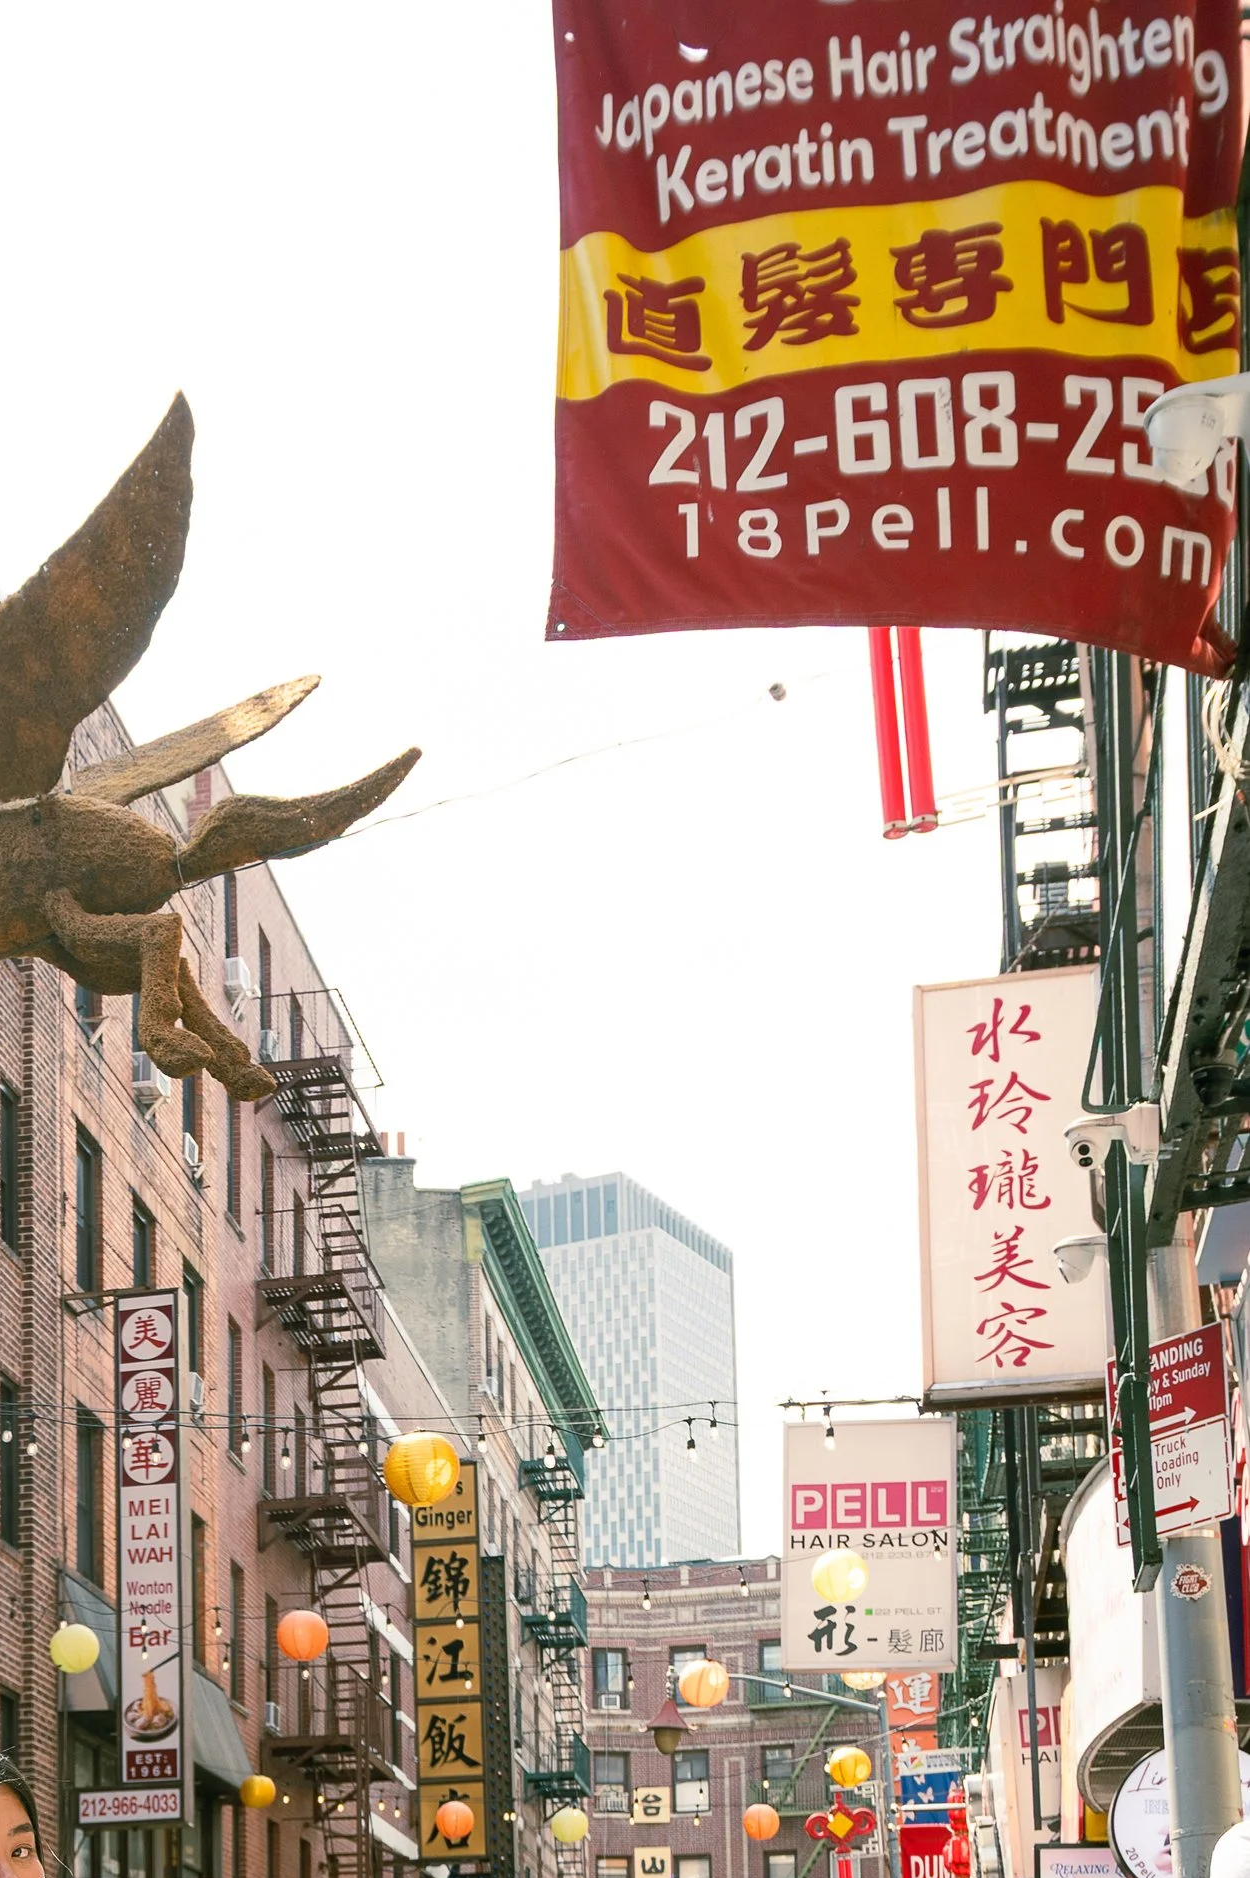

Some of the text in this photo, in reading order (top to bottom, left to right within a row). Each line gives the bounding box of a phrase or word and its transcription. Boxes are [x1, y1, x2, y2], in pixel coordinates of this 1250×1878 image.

[596, 53, 813, 155] Japanese
[829, 30, 936, 98] Hair
[657, 93, 1189, 224] Keratin Treatment
[649, 371, 1238, 512] 212-608-25
[966, 997, 1055, 1368] 水玲瓏美容
[1150, 1338, 1203, 1372] ANDING
[1162, 1373, 1170, 1388] &
[1172, 1361, 1211, 1384] Sunday
[1154, 1436, 1186, 1457] Truck
[1155, 1450, 1199, 1473] Loading
[1157, 1473, 1181, 1490] Only
[128, 1498, 170, 1517] MEI
[795, 1486, 941, 1525] PELL
[415, 1506, 473, 1531] Ginger
[131, 1522, 168, 1541] LAI
[791, 1531, 948, 1550] HAIR SALON
[127, 1546, 173, 1564] WAH
[126, 1581, 173, 1596] Wonton
[129, 1599, 172, 1616] Noodle
[895, 1607, 923, 1615] PELL
[129, 1626, 173, 1648] Bar
[1022, 1750, 1058, 1765] HAI
[130, 1765, 172, 1778] 1964
[81, 1793, 178, 1817] 212-966-4033
[1125, 1847, 1139, 1861] 20
